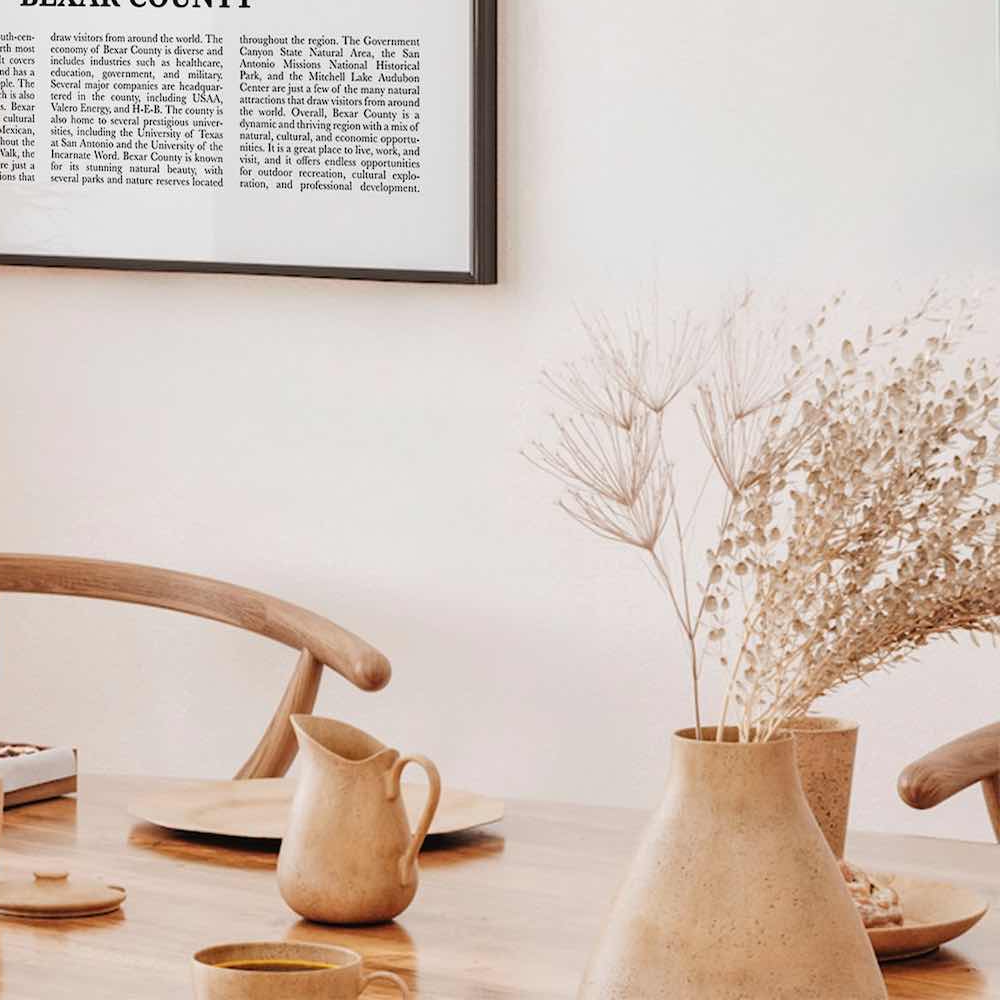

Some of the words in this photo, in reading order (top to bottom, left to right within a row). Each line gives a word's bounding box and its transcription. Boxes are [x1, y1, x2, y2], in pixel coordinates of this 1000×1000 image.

[50, 32, 72, 42] draw
[73, 32, 104, 42] visitors
[105, 33, 126, 43] from
[127, 33, 158, 43] around
[160, 33, 174, 43] the
[175, 34, 203, 44] world.
[204, 34, 223, 44] The
[239, 34, 288, 47] throughout
[291, 35, 306, 45] the
[308, 35, 339, 48] region.
[341, 35, 361, 46] The
[363, 36, 420, 47] Government
[15, 44, 35, 53] most
[50, 55, 85, 66] includes
[90, 56, 131, 66] industries
[136, 57, 156, 67] such
[176, 57, 223, 69] healthcare,
[239, 58, 276, 69] Antonio
[283, 59, 321, 69] Missions
[329, 59, 368, 70] National
[376, 60, 420, 71] Historical
[13, 66, 27, 76] has
[50, 79, 81, 89] Several
[84, 81, 110, 92] major
[113, 80, 159, 93] companies
[179, 81, 223, 94] headquar-
[239, 82, 270, 93] Center
[288, 85, 304, 96] just
[313, 83, 330, 94] few
[331, 84, 341, 94] of
[344, 84, 358, 94] the
[360, 87, 386, 97] many
[387, 85, 420, 95] natural
[10, 90, 17, 99] is
[18, 90, 35, 100] also
[51, 103, 78, 113] Valero
[80, 103, 112, 116] Energy,
[113, 104, 130, 114] and
[132, 104, 163, 114] H-E-B.
[164, 105, 183, 115] The
[184, 106, 215, 118] county
[216, 106, 224, 116] is
[239, 106, 254, 117] the
[258, 107, 286, 117] world.
[291, 107, 328, 119] Overall,
[332, 108, 359, 119] Bexar
[363, 109, 398, 122] County
[402, 109, 410, 120] is
[2, 113, 35, 123] cultural
[50, 126, 74, 138] sities,
[76, 127, 117, 140] including
[119, 128, 134, 138] the
[137, 128, 182, 141] University
[184, 129, 195, 139] of
[198, 129, 224, 140] Texas
[239, 130, 274, 143] natural,
[276, 131, 313, 143] cultural,
[315, 132, 333, 142] and
[335, 132, 378, 143] economic
[380, 135, 420, 146] opportu-
[21, 148, 35, 158] the
[240, 143, 265, 153] nities.
[268, 143, 275, 153] It
[277, 143, 284, 154] is
[294, 145, 317, 157] great
[318, 144, 342, 157] place
[344, 146, 354, 155] to
[355, 145, 374, 157] live,
[375, 145, 401, 157] work,
[403, 146, 420, 156] and
[51, 150, 91, 160] Incarnate
[94, 151, 120, 161] Word.
[123, 151, 148, 162] Bexar
[150, 152, 183, 165] County
[185, 153, 192, 163] is
[194, 153, 223, 163] known
[239, 155, 260, 166] visit,
[264, 155, 281, 166] and
[285, 156, 292, 166] it
[296, 156, 321, 166] offers
[324, 156, 357, 167] endless
[360, 157, 421, 171] opportunities
[18, 172, 35, 182] that
[50, 173, 79, 184] several
[82, 174, 105, 187] parks
[107, 175, 123, 185] and
[125, 176, 154, 186] nature
[192, 177, 224, 187] located
[240, 179, 269, 191] ration,
[276, 180, 293, 190] and
[300, 180, 353, 194] professional
[360, 181, 420, 195] development.
